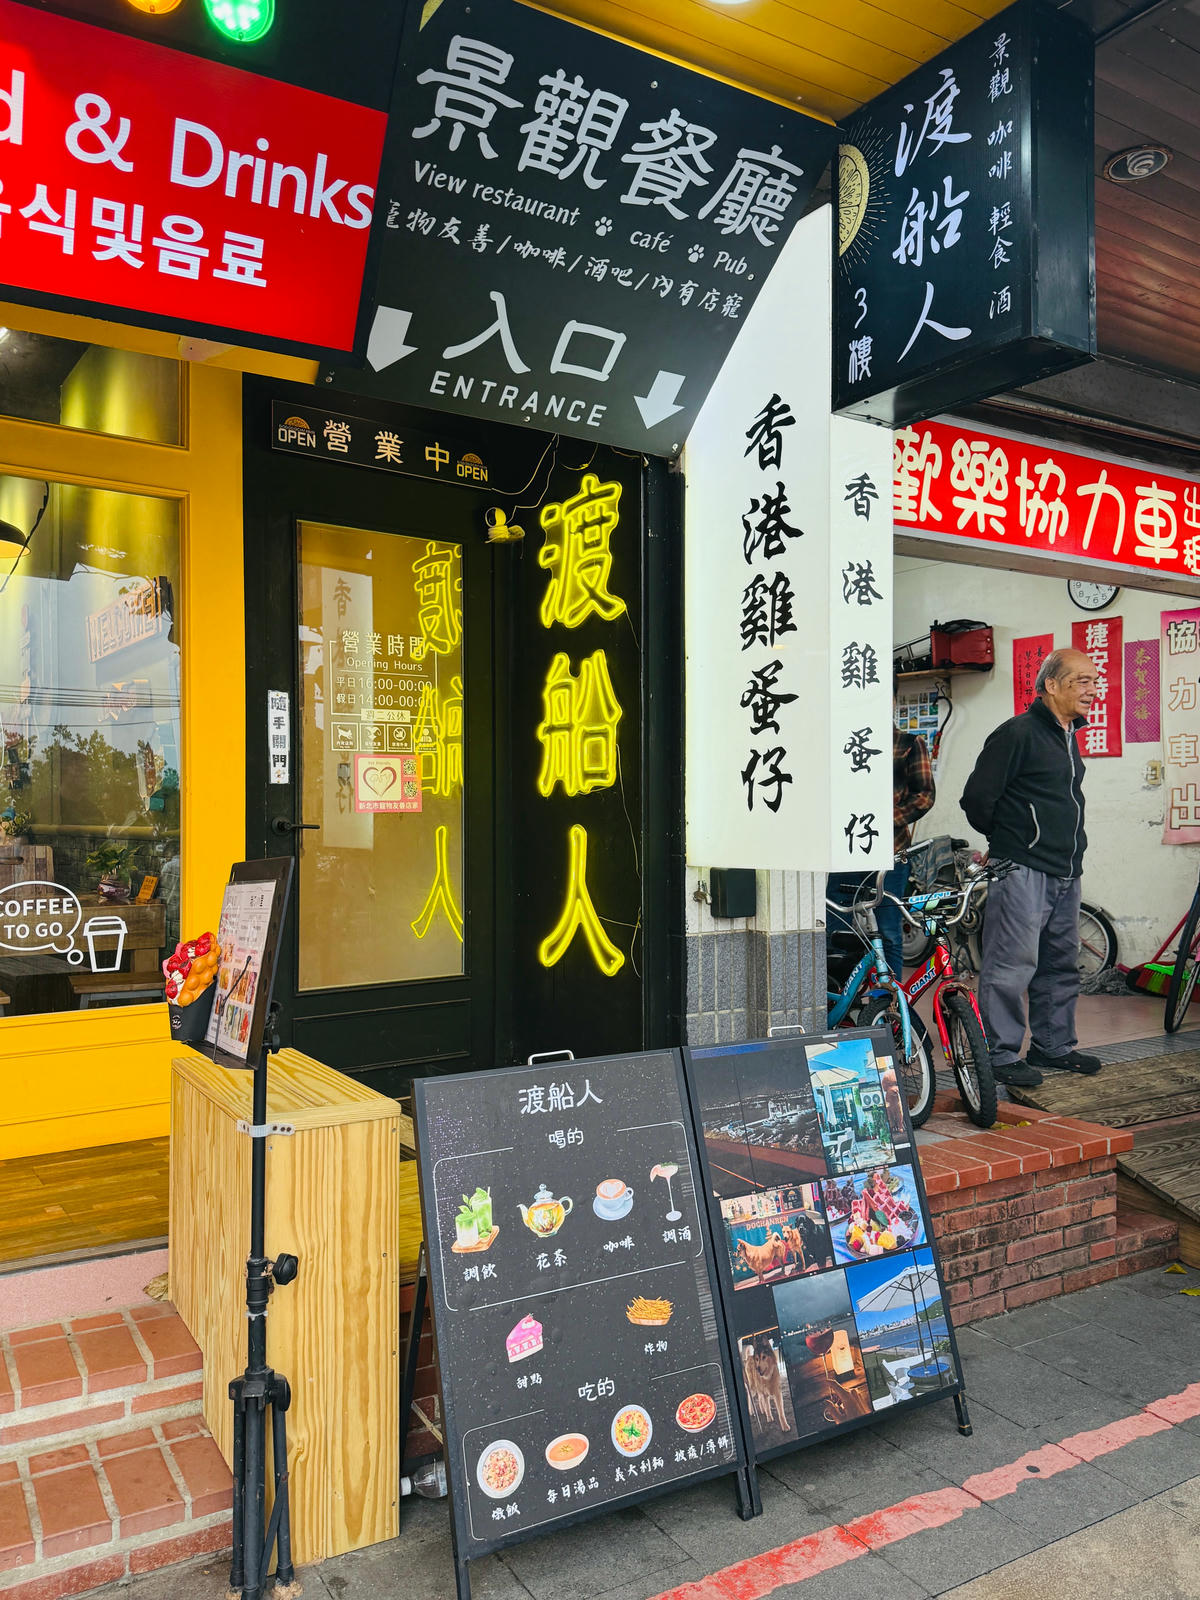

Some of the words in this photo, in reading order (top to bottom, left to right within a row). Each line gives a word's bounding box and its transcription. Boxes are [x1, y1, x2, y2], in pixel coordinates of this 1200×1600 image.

[987, 32, 1014, 104] 景觀
[411, 34, 805, 249] 景觀餐廳
[986, 119, 1014, 181] 咖啡
[64, 92, 136, 174] &
[169, 116, 376, 231] Drinks
[414, 160, 468, 195] View
[472, 181, 582, 228] restaurant
[630, 228, 674, 256] café
[892, 67, 973, 364] 渡船人
[0, 175, 268, 289] 식및음료
[987, 200, 1014, 270] 輕食
[988, 285, 1013, 320] 酒
[442, 290, 628, 382] 入口
[428, 370, 608, 428] ENTRANCE
[277, 427, 317, 449] OPEN
[322, 418, 451, 473] 營業中
[456, 462, 489, 483] OPEN
[893, 425, 1179, 565] 歡樂協力車
[740, 392, 805, 814] 香港雞蛋仔
[342, 630, 426, 659] 營業時間
[841, 472, 884, 855] 香港雞蛋仔
[335, 676, 357, 688] 平日
[346, 656, 389, 671] Opening
[393, 659, 424, 672] Hours
[537, 473, 627, 977] 渡船人
[908, 890, 952, 904] GIANT
[4, 923, 30, 939] TO
[35, 921, 63, 938] GO
[842, 961, 865, 998] GIANT
[908, 966, 937, 996] GIANT
[518, 1078, 604, 1116] 渡船人
[548, 1127, 584, 1149] 喝的
[536, 1249, 568, 1271] 花茶
[603, 1234, 636, 1253] 咖啡
[578, 1376, 616, 1402] 吃的
[546, 1476, 600, 1504] 每日湯品
